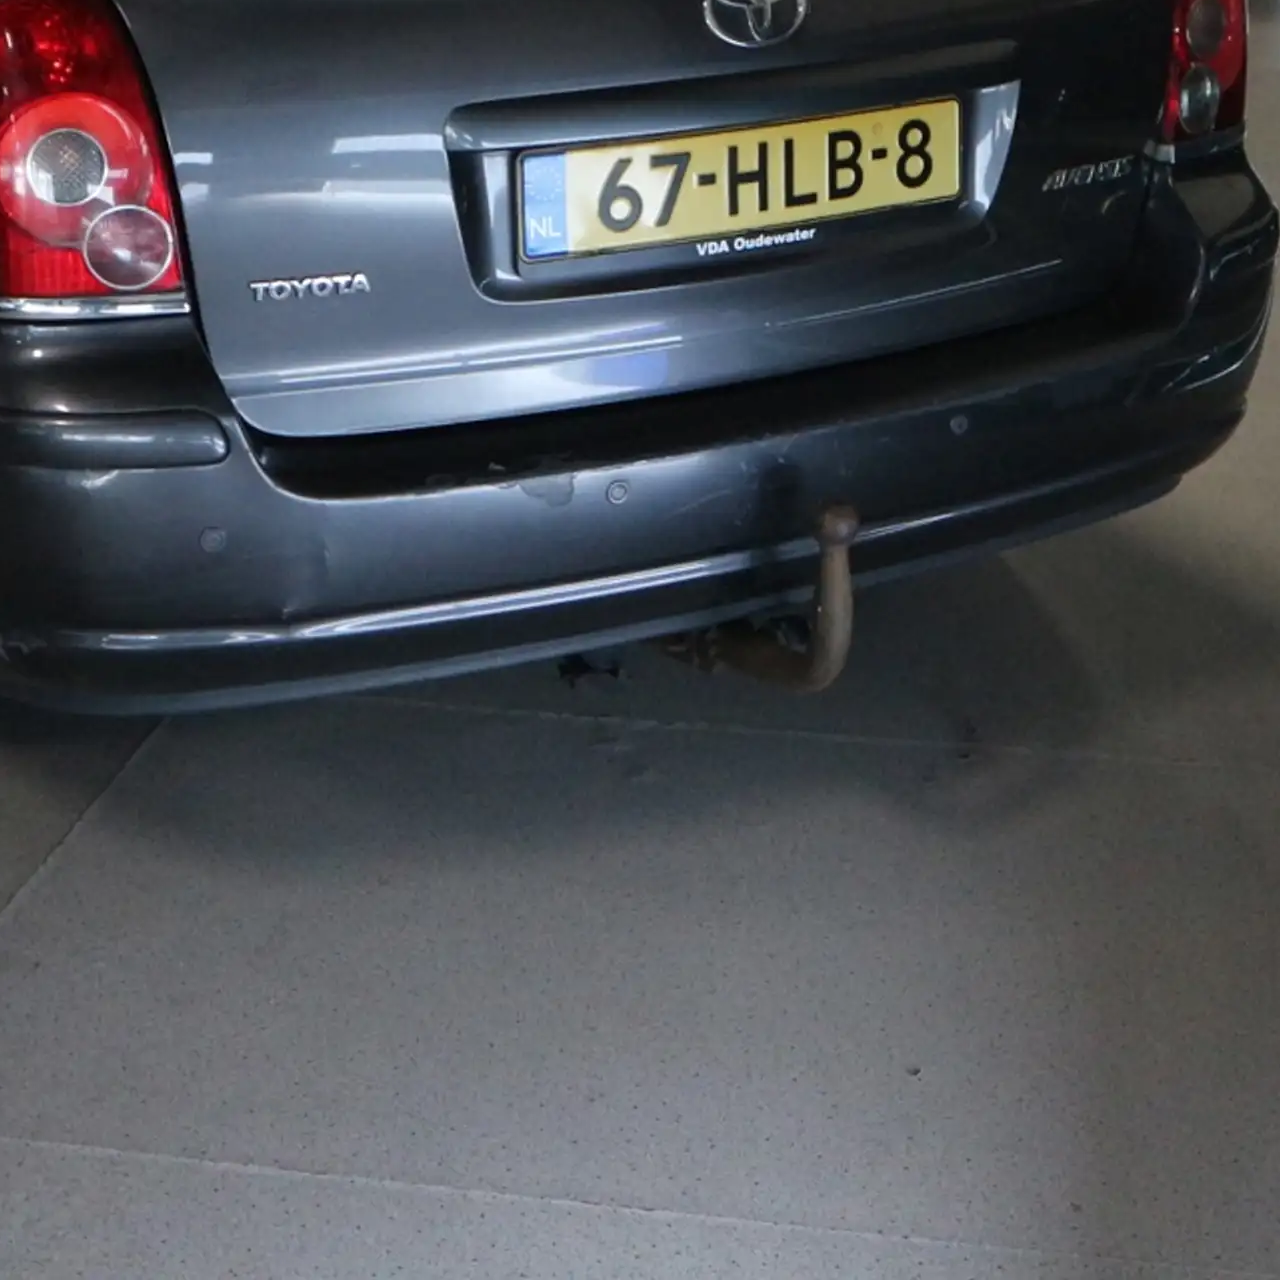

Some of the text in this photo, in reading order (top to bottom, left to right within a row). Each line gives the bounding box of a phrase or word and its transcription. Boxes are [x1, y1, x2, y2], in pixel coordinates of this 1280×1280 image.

[596, 118, 935, 232] 67-HLB-8
[529, 216, 561, 239] NL
[696, 226, 817, 257] VDA Oudewater
[250, 272, 372, 302] TOYOTA
